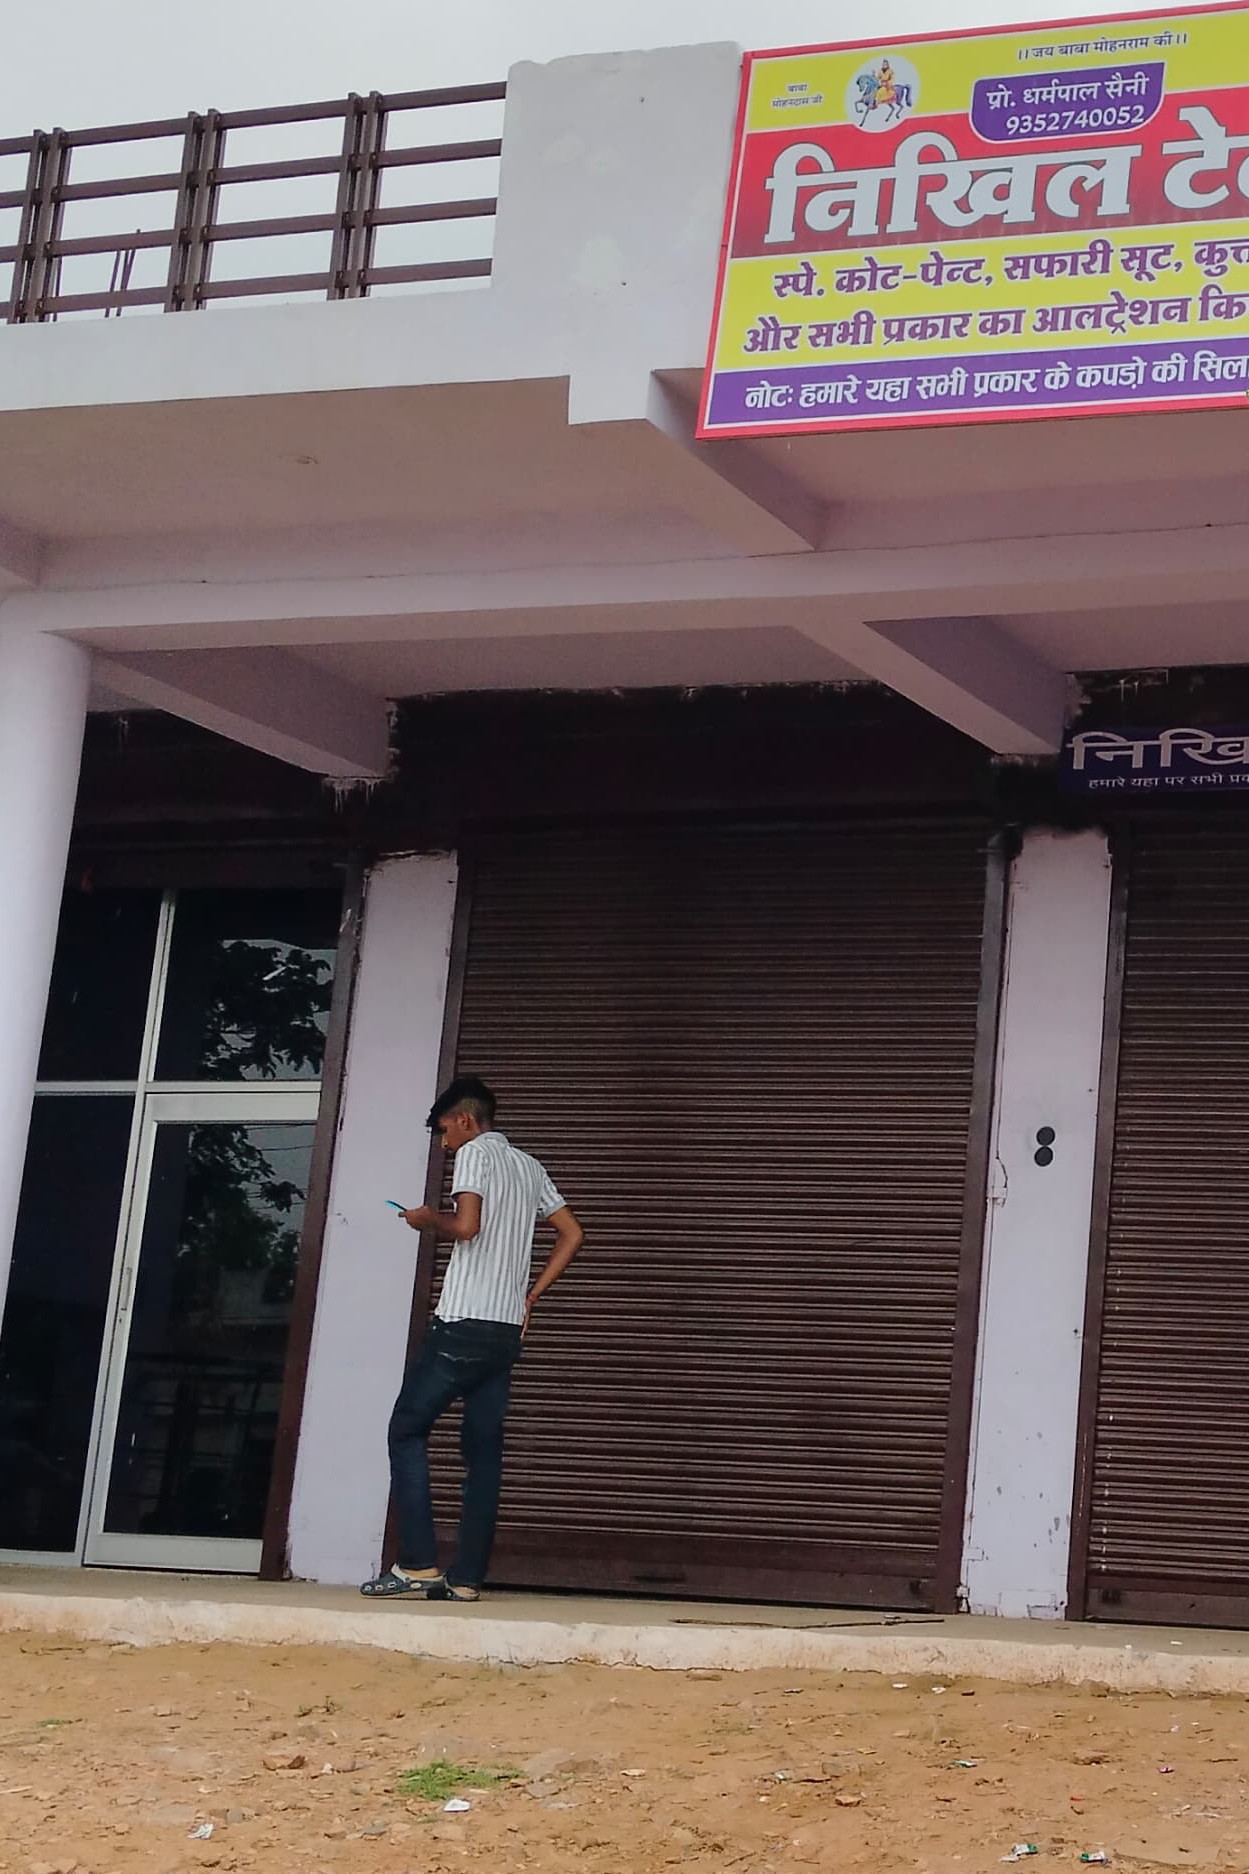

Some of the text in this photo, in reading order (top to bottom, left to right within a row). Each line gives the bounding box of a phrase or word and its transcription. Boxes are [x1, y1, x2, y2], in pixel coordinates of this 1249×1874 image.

[1058, 42, 1089, 55] बाबा
[1093, 36, 1149, 52] मोहनराम
[986, 71, 1150, 110] प्रो. धर्मपाल सैनी
[1006, 104, 1145, 135] 9352740052
[763, 131, 1140, 245] निखिल
[773, 261, 825, 298] स्पे.
[1004, 238, 1114, 281] सफारी
[1120, 244, 1183, 282] सूट,
[743, 316, 803, 353] और
[808, 310, 877, 347] सभी
[882, 313, 974, 345] प्रकार
[978, 309, 1026, 336] का
[1032, 290, 1192, 334] आलट्रेशन
[799, 374, 861, 408] हमारे
[865, 376, 912, 402] यहा
[916, 366, 969, 400] सभी
[973, 371, 1041, 397] प्रकार
[1043, 361, 1072, 391] के
[1151, 352, 1190, 384] की
[1088, 775, 1126, 789] हमारे
[1130, 775, 1160, 787] यहा
[1164, 774, 1186, 786] पर
[1191, 771, 1224, 785] सभी
